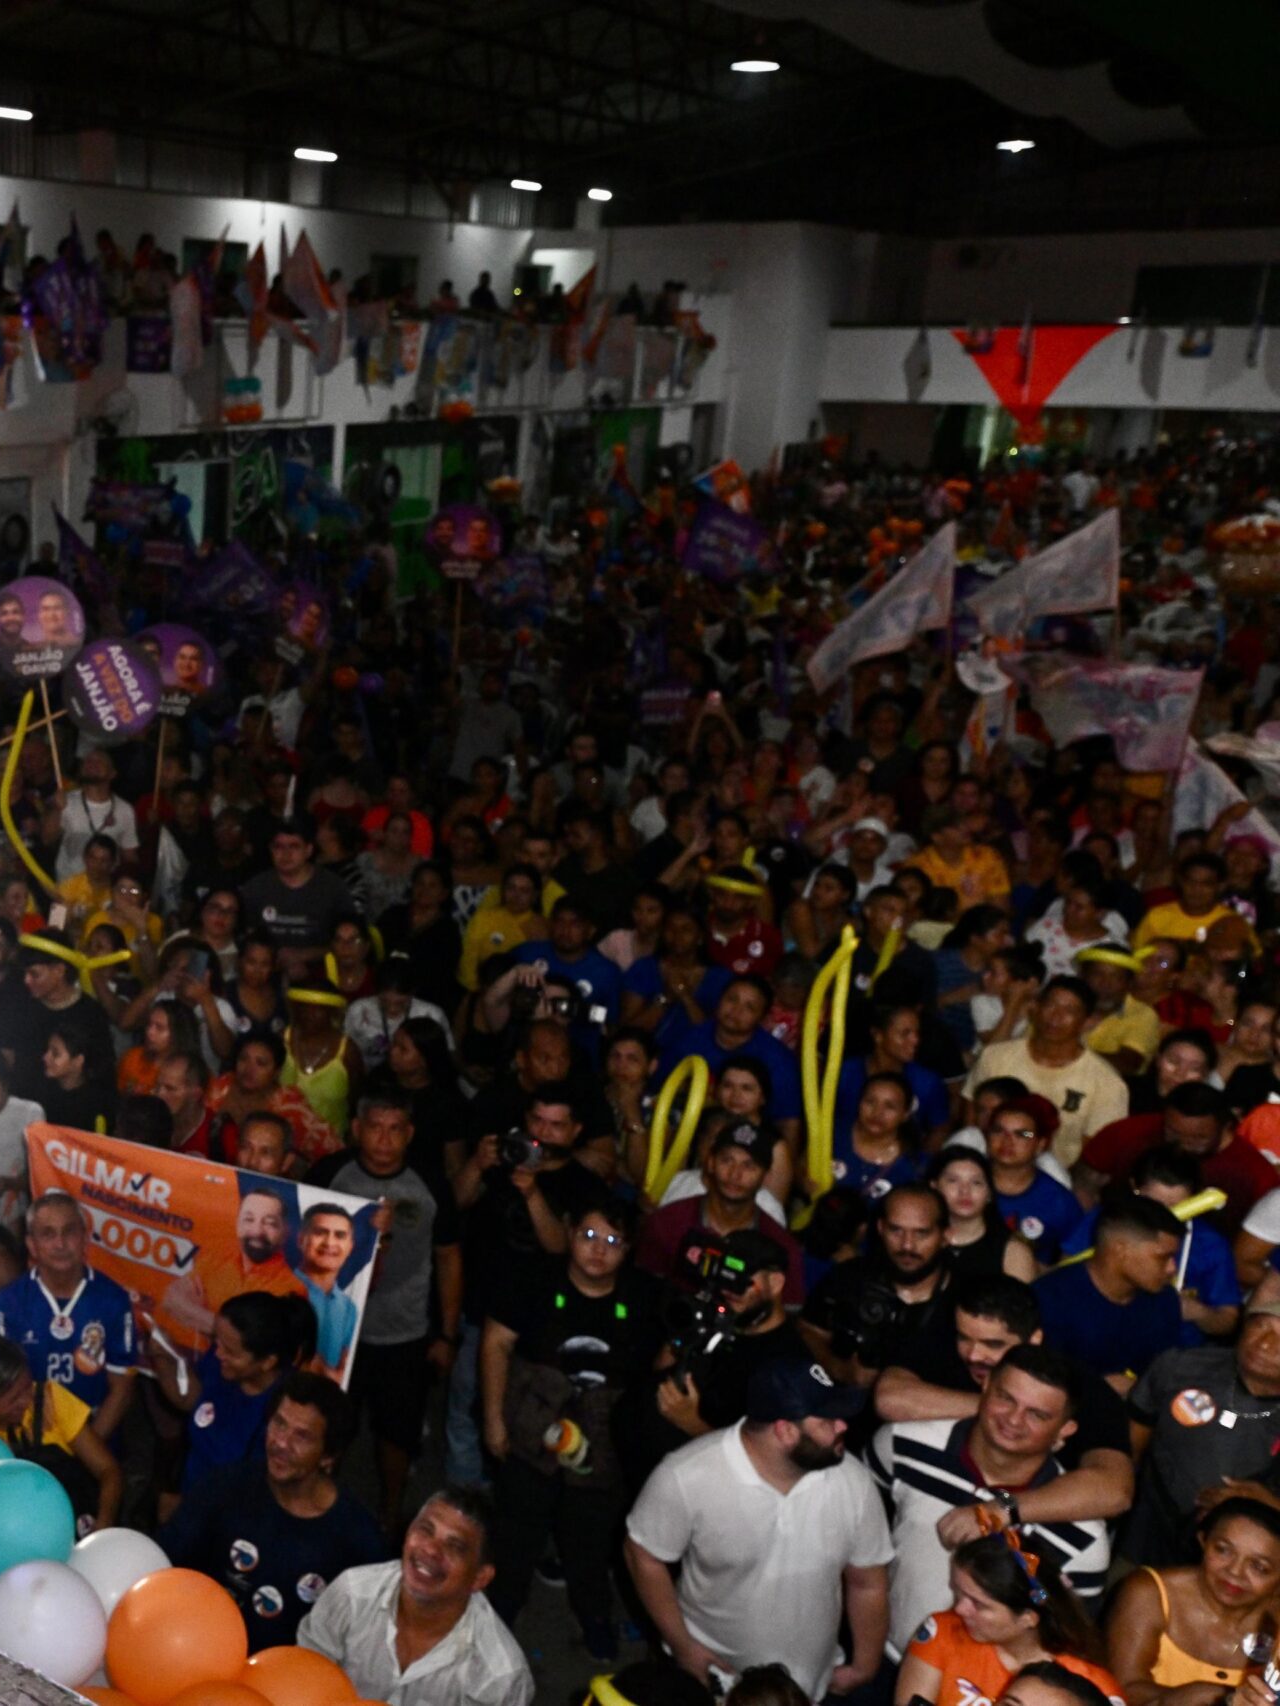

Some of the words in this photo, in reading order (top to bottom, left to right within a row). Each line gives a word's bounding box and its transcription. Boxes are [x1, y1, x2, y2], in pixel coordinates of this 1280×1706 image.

[75, 660, 118, 732] JANJÃO
[106, 644, 144, 704] AGORA
[134, 701, 153, 716] É
[43, 1138, 173, 1210] GILMAR
[81, 1183, 194, 1233] NASCIMENTO
[46, 1352, 76, 1385] 23
